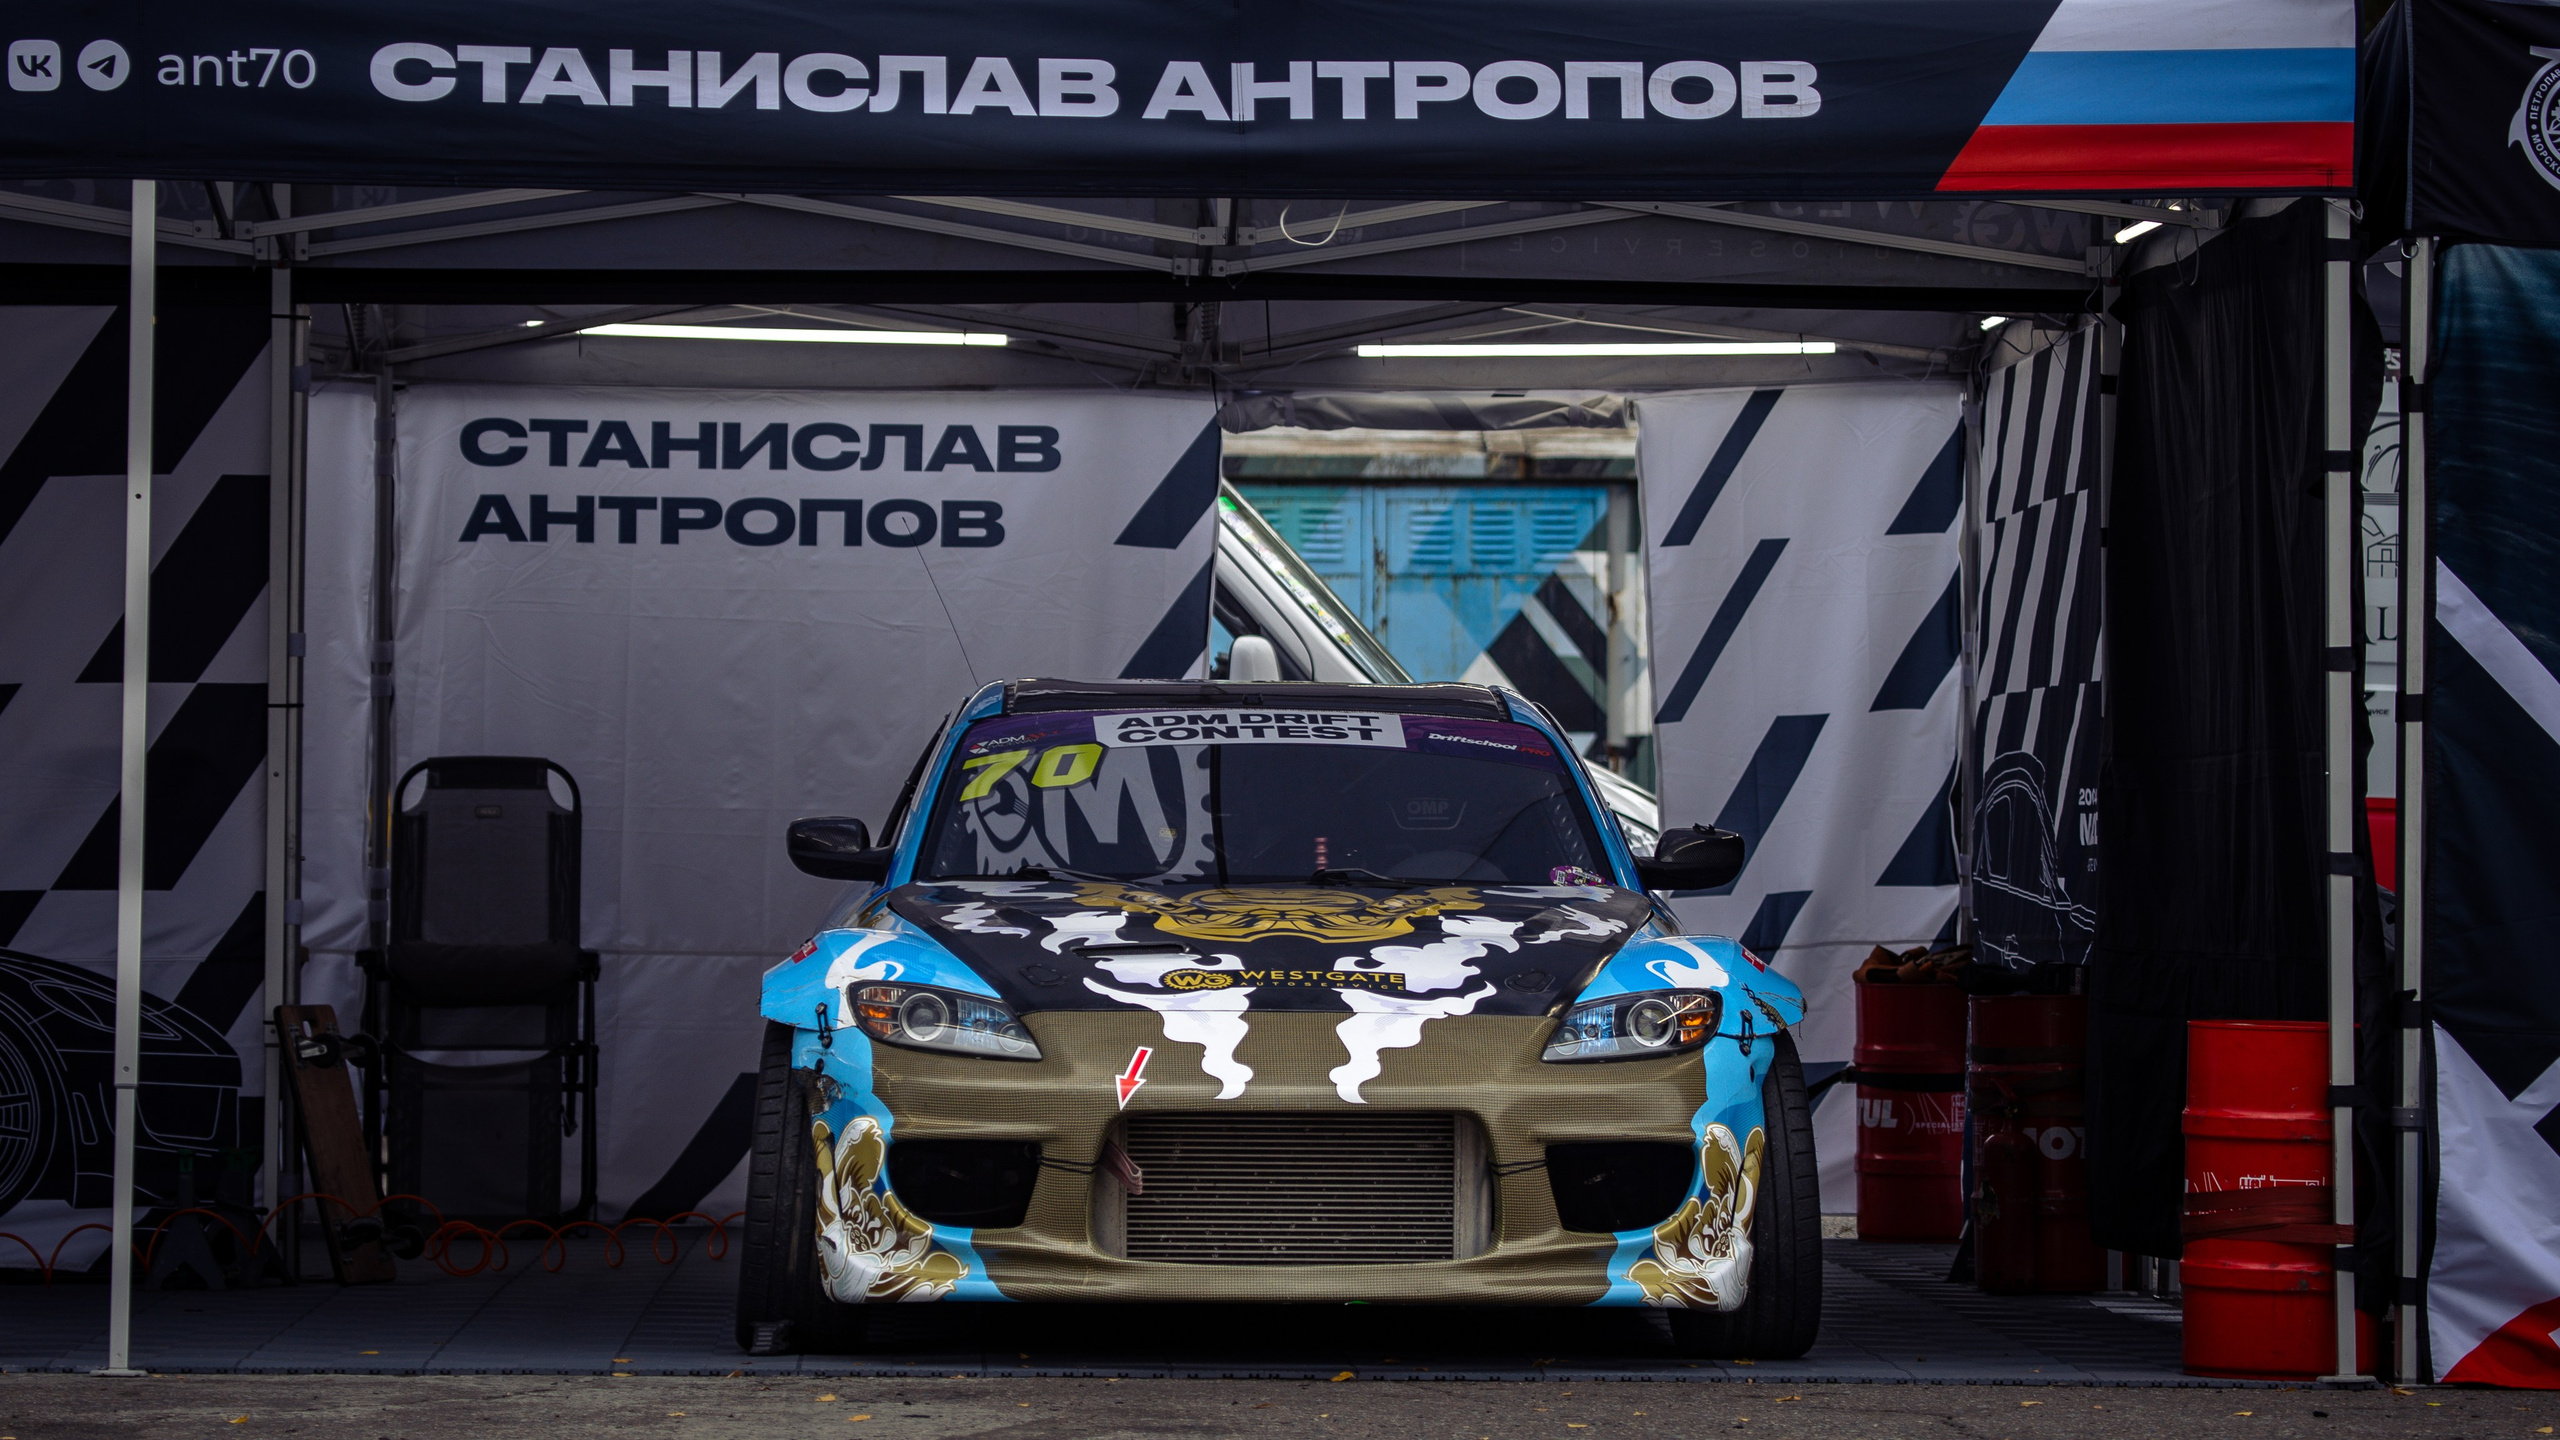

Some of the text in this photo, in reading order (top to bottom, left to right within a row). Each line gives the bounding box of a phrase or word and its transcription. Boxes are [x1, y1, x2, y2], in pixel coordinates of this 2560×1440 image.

[158, 48, 316, 89] ant70
[370, 42, 1822, 121] СТАНИСЛАВ АНТРОПОВ
[459, 417, 1061, 473] СТАНИСЛАВ
[458, 494, 1005, 549] АНТРОПОВ
[1117, 713, 1380, 730] ADM DRIFT
[988, 734, 1025, 747] ADM
[1117, 725, 1383, 743] CONTEST
[959, 743, 1103, 802] 70
[1407, 801, 1448, 815] OMP
[1240, 970, 1404, 984] WESTGATE
[1240, 981, 1405, 991] AUTOSERVICE
